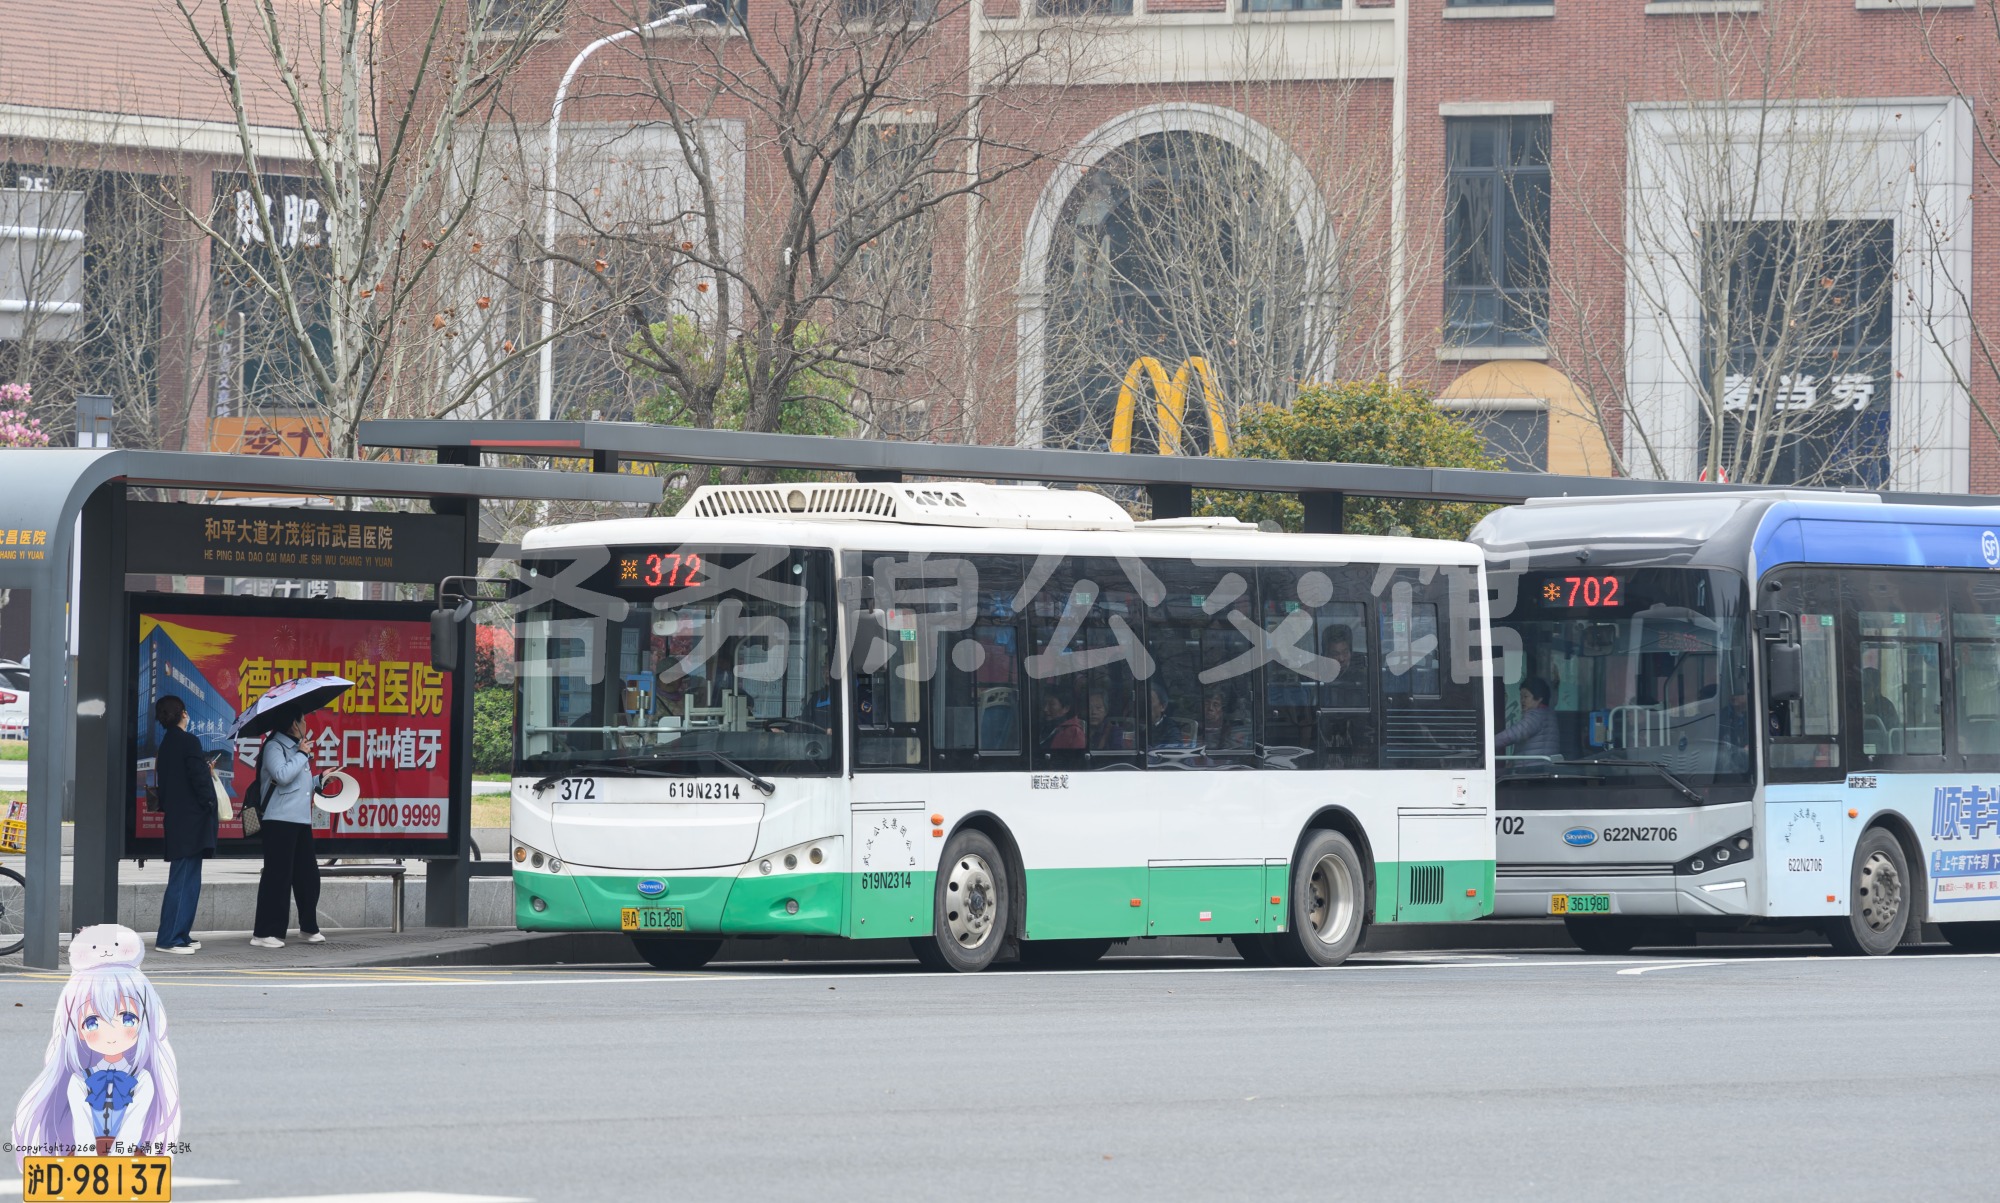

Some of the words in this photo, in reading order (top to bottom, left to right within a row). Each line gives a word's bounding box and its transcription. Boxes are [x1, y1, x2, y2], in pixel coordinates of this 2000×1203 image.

[204, 517, 393, 550] 和平大道才茂街市武昌医院
[20, 550, 25, 559] YI
[28, 550, 44, 560] YUAN
[204, 550, 213, 559] HE
[216, 550, 232, 560] PING
[236, 551, 245, 561] DA
[248, 552, 262, 562] DAO
[266, 552, 276, 562] CAI
[280, 553, 296, 563] MAO
[299, 554, 308, 564] JIE
[311, 554, 321, 565] SHI
[325, 555, 336, 565] WU
[340, 555, 362, 566] CHANG
[366, 556, 372, 566] YI
[375, 556, 392, 567] YUAN
[644, 554, 701, 586] 372
[1565, 576, 1619, 606] 702
[236, 726, 442, 768] 专全口种植牙
[561, 778, 596, 800] 372
[669, 782, 740, 800] 619N2314
[358, 804, 398, 827] 8700
[402, 804, 440, 826] 9999
[1604, 827, 1677, 842] 622N2706
[1788, 858, 1822, 872] 622N2706
[862, 872, 911, 889] 619N2314
